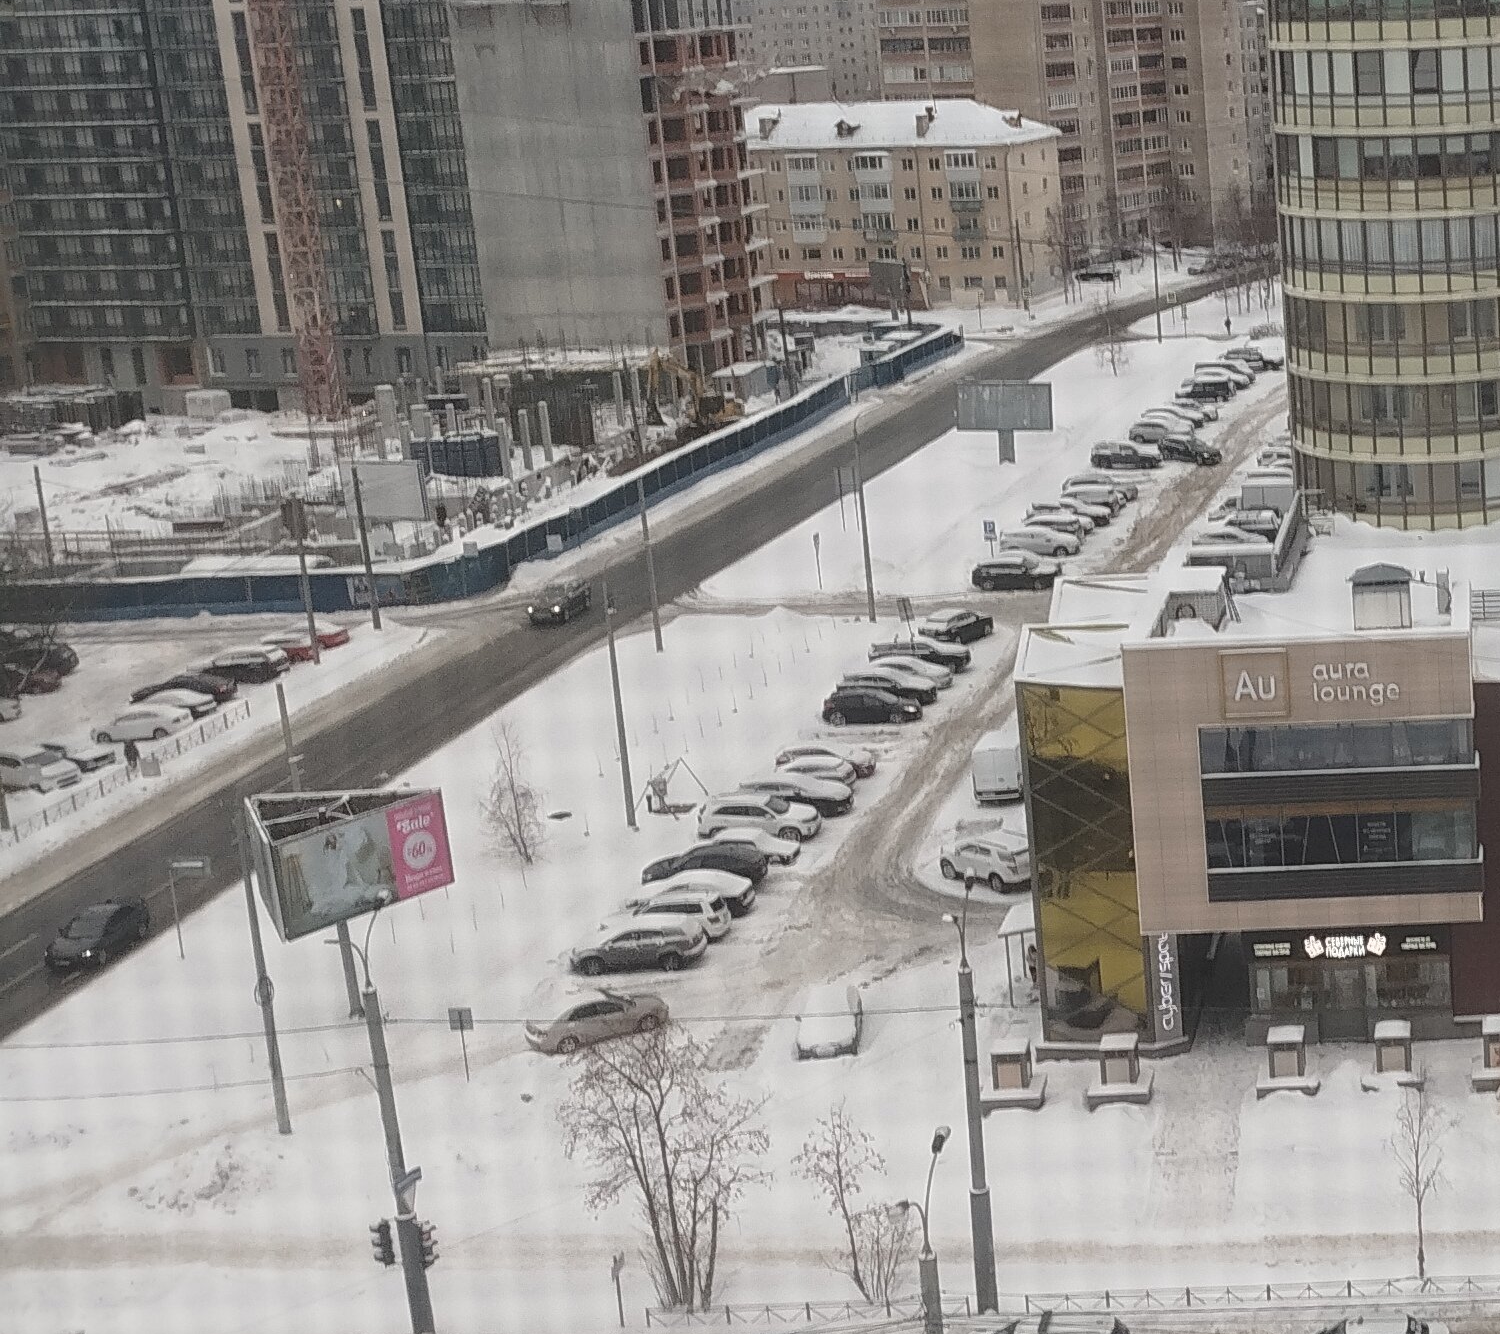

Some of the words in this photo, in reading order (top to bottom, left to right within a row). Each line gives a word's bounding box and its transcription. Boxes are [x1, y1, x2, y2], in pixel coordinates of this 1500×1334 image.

[1312, 662, 1370, 680] aura
[1234, 669, 1276, 702] Au
[1312, 682, 1400, 707] lounge
[1325, 935, 1364, 947] СЕВЕРНЫЕ
[1325, 945, 1366, 959] ПОДАРКИ
